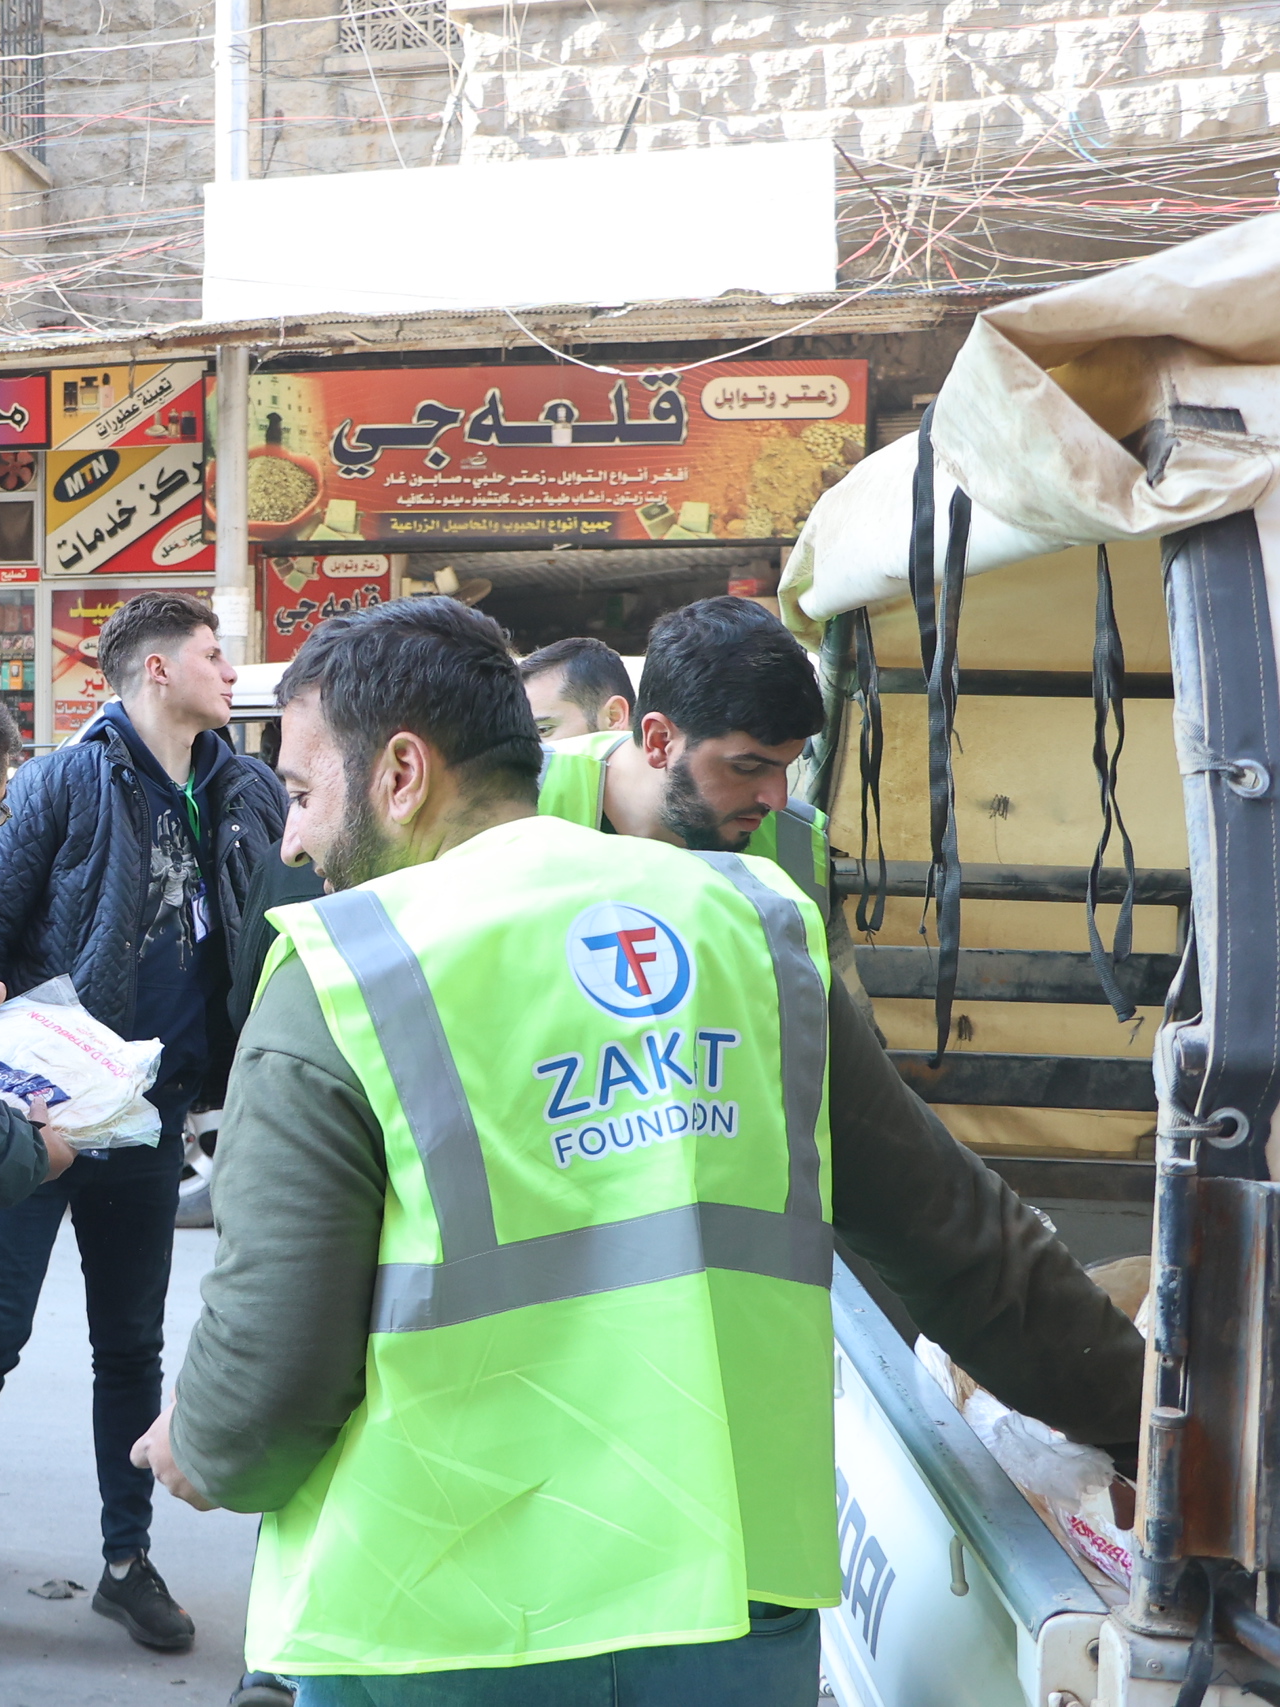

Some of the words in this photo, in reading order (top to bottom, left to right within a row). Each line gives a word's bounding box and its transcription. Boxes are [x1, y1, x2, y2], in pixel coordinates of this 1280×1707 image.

[714, 385, 777, 410] وتوابل
[781, 384, 837, 408] زعتر
[96, 404, 140, 437] عطورات
[329, 399, 466, 480] جي
[63, 454, 110, 499] MTN
[383, 472, 407, 487] غار
[408, 472, 462, 488] صابون
[472, 472, 507, 488] حلبي
[507, 470, 547, 486] زعتر
[556, 469, 607, 486] التوابل
[609, 467, 649, 486] أنواع
[650, 467, 689, 485] أفخر
[139, 461, 203, 516] ركز
[517, 493, 535, 507] بن
[542, 492, 571, 507] طبية
[572, 490, 605, 506] أعشاب
[612, 491, 643, 506] زيتون
[644, 491, 668, 506] زيت
[390, 518, 440, 534] الزراعية
[442, 518, 500, 534] والمحاصيل
[502, 518, 546, 534] الحبوب
[548, 517, 578, 533] أنواع
[580, 519, 613, 534] جميع
[57, 499, 138, 569] خدمات
[330, 560, 358, 574] وتوابل
[360, 559, 380, 572] زعتر
[0, 570, 27, 583] تصليح
[274, 597, 320, 635] جي
[56, 702, 93, 714] خدمات
